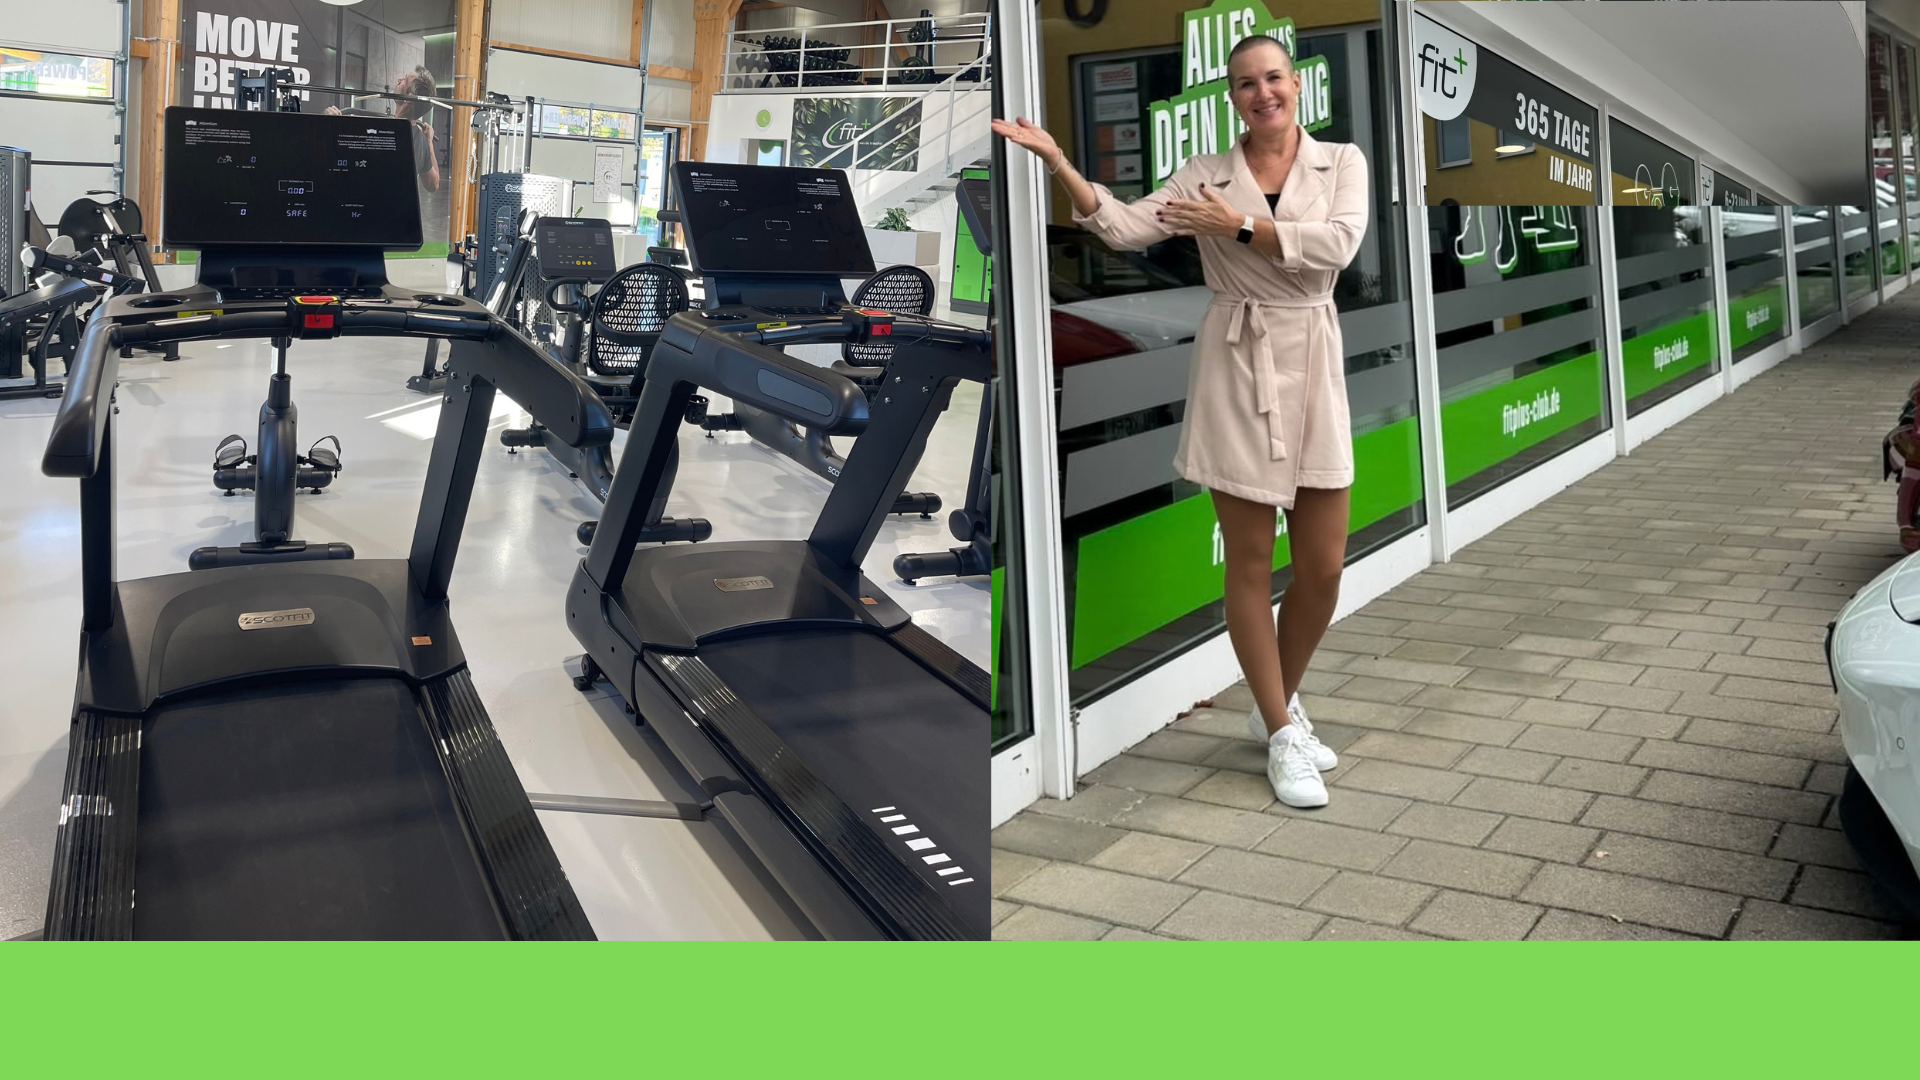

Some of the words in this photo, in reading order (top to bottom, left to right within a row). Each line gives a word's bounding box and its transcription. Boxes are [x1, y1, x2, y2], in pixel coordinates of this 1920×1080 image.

[195, 11, 299, 63] MOVE
[1418, 43, 1468, 99] fit+
[839, 119, 872, 141] fit+
[1154, 95, 1218, 180] DEIN
[1514, 92, 1550, 140] 365
[1553, 110, 1591, 158] TAGE
[1550, 155, 1565, 184] IM
[1566, 163, 1593, 192] JAHR
[286, 209, 308, 217] SAFE
[1654, 335, 1689, 372] fitplus-club.de
[1503, 386, 1560, 437] fitplus-club.de
[253, 612, 312, 624] SCOTFIT
